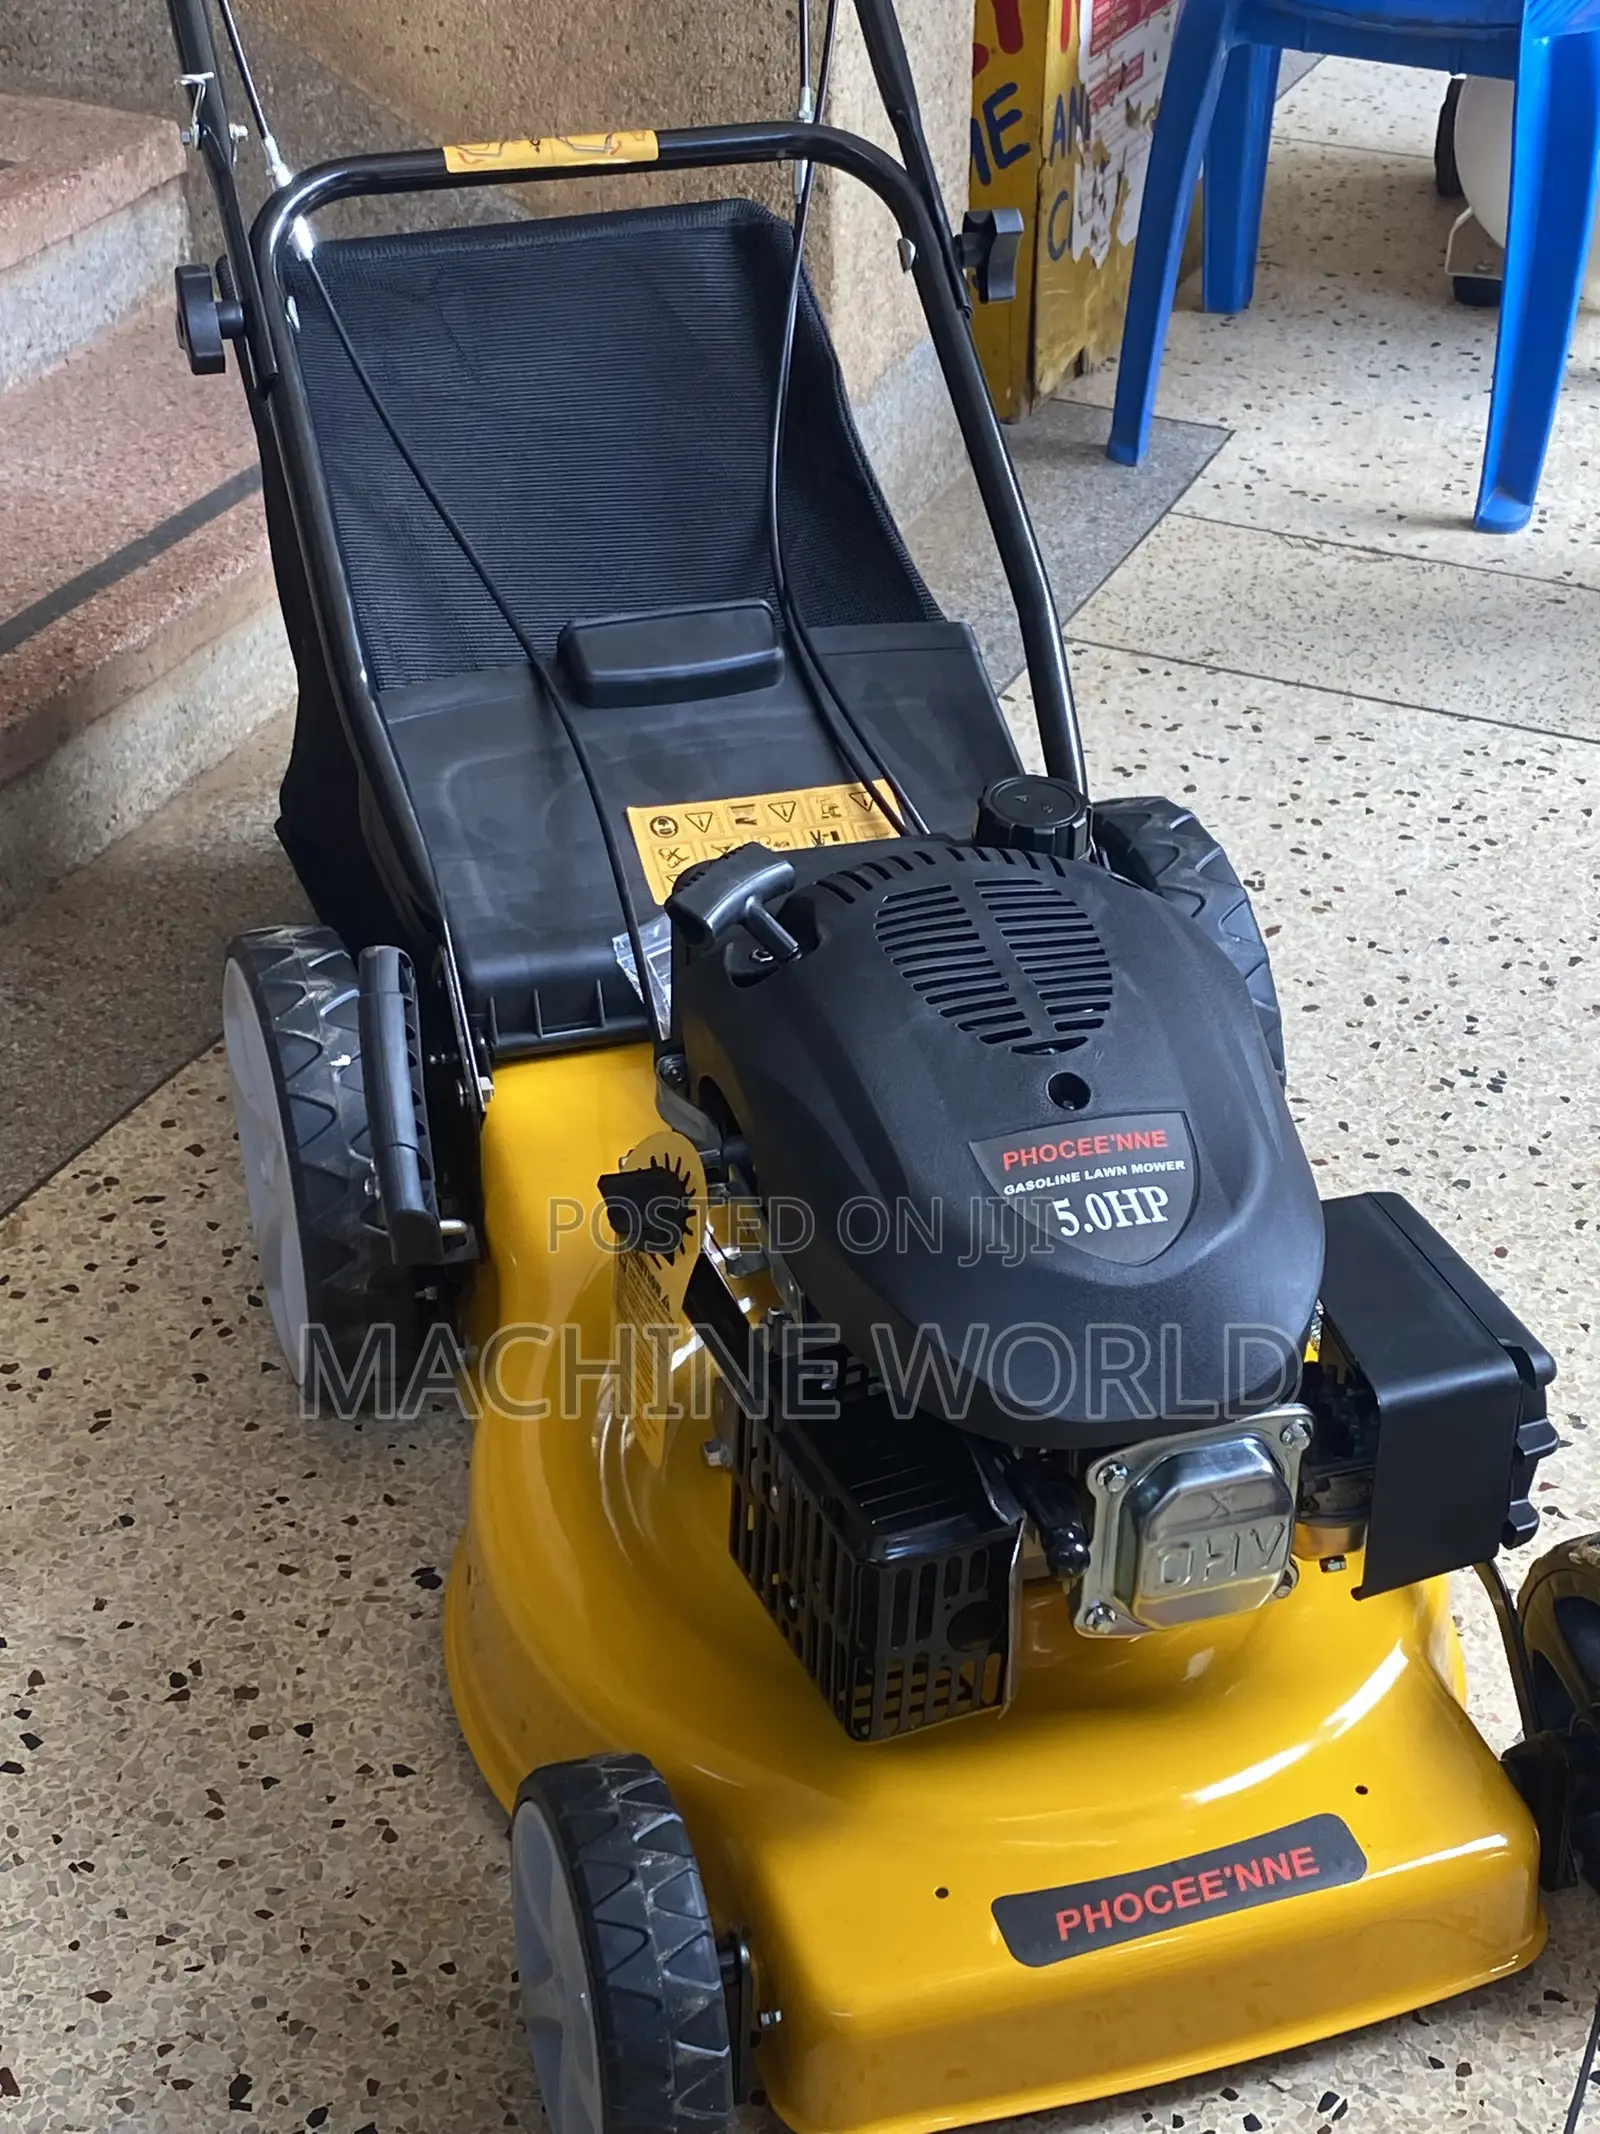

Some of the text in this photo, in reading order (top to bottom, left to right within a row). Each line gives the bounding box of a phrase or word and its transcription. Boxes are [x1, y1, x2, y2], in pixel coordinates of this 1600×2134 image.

[1002, 1128, 1169, 1172] PHOCEE'NNE
[1003, 1160, 1186, 1196] GASOLINE LAWN MOWER
[1053, 1184, 1169, 1237] 5.0HP
[1157, 1521, 1287, 1587] OHV
[1055, 1846, 1321, 1941] PHOCEE'NNE
